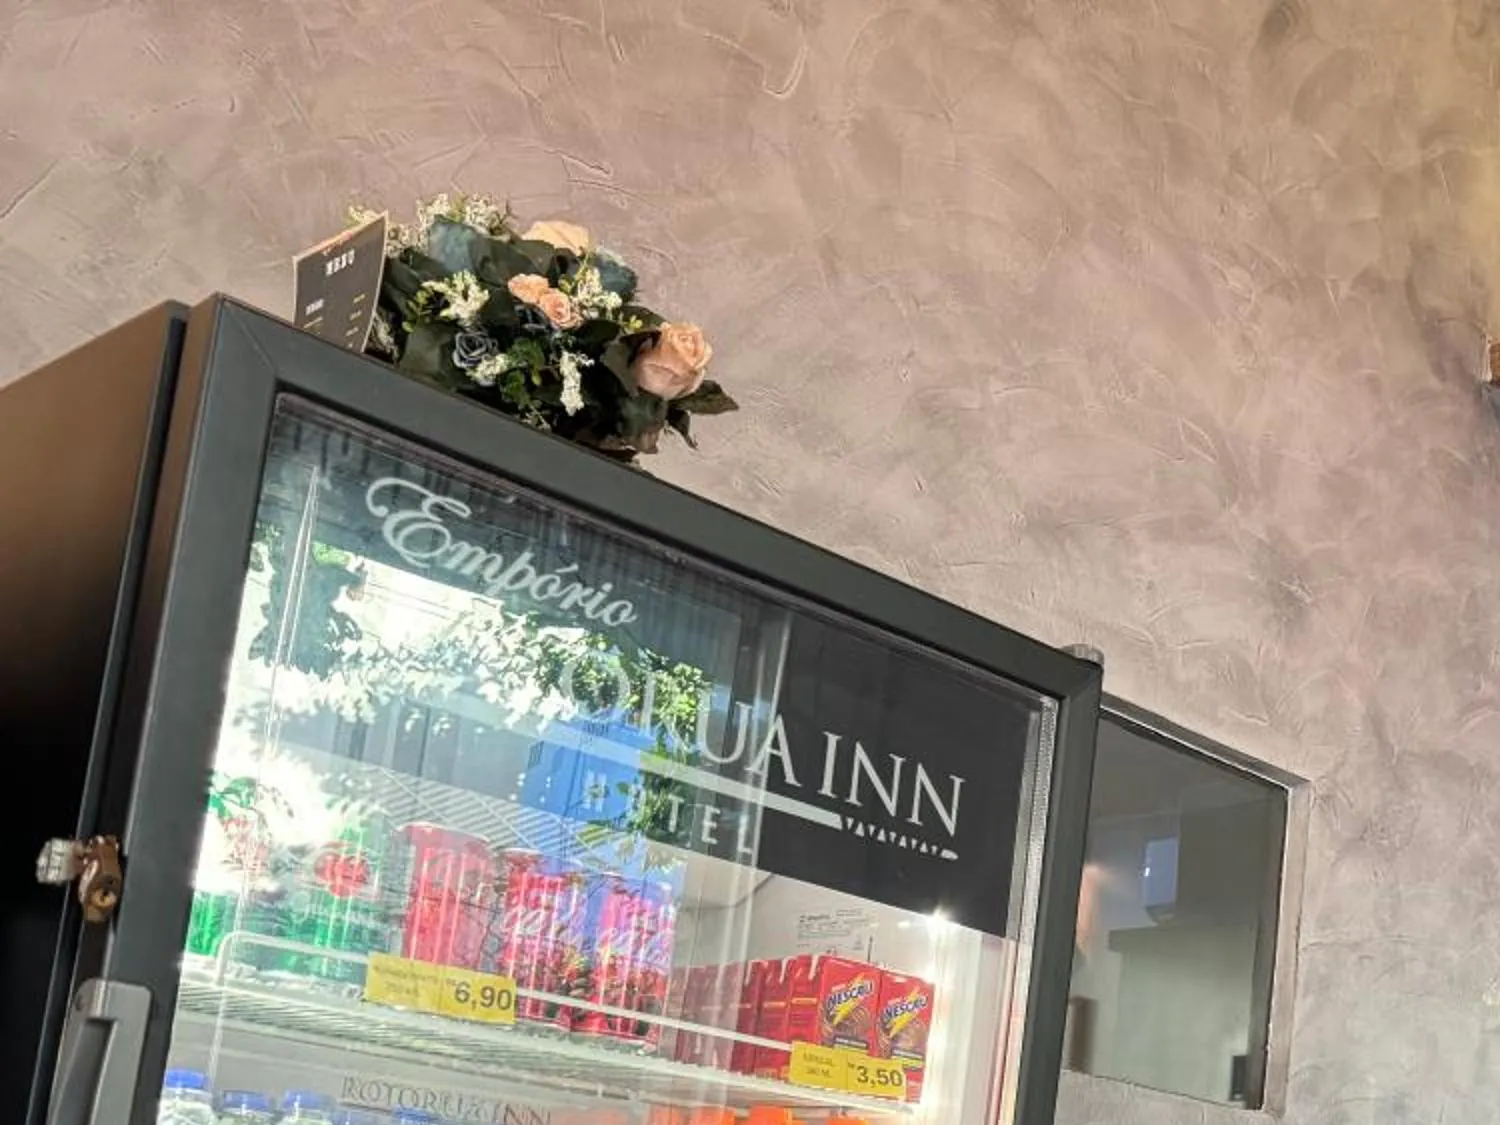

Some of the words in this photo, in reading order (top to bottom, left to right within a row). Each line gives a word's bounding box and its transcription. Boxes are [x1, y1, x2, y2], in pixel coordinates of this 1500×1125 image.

[365, 476, 638, 627] Empório
[816, 730, 967, 839] INN
[454, 981, 513, 1012] 6,90
[856, 1064, 903, 1088] 3,50
